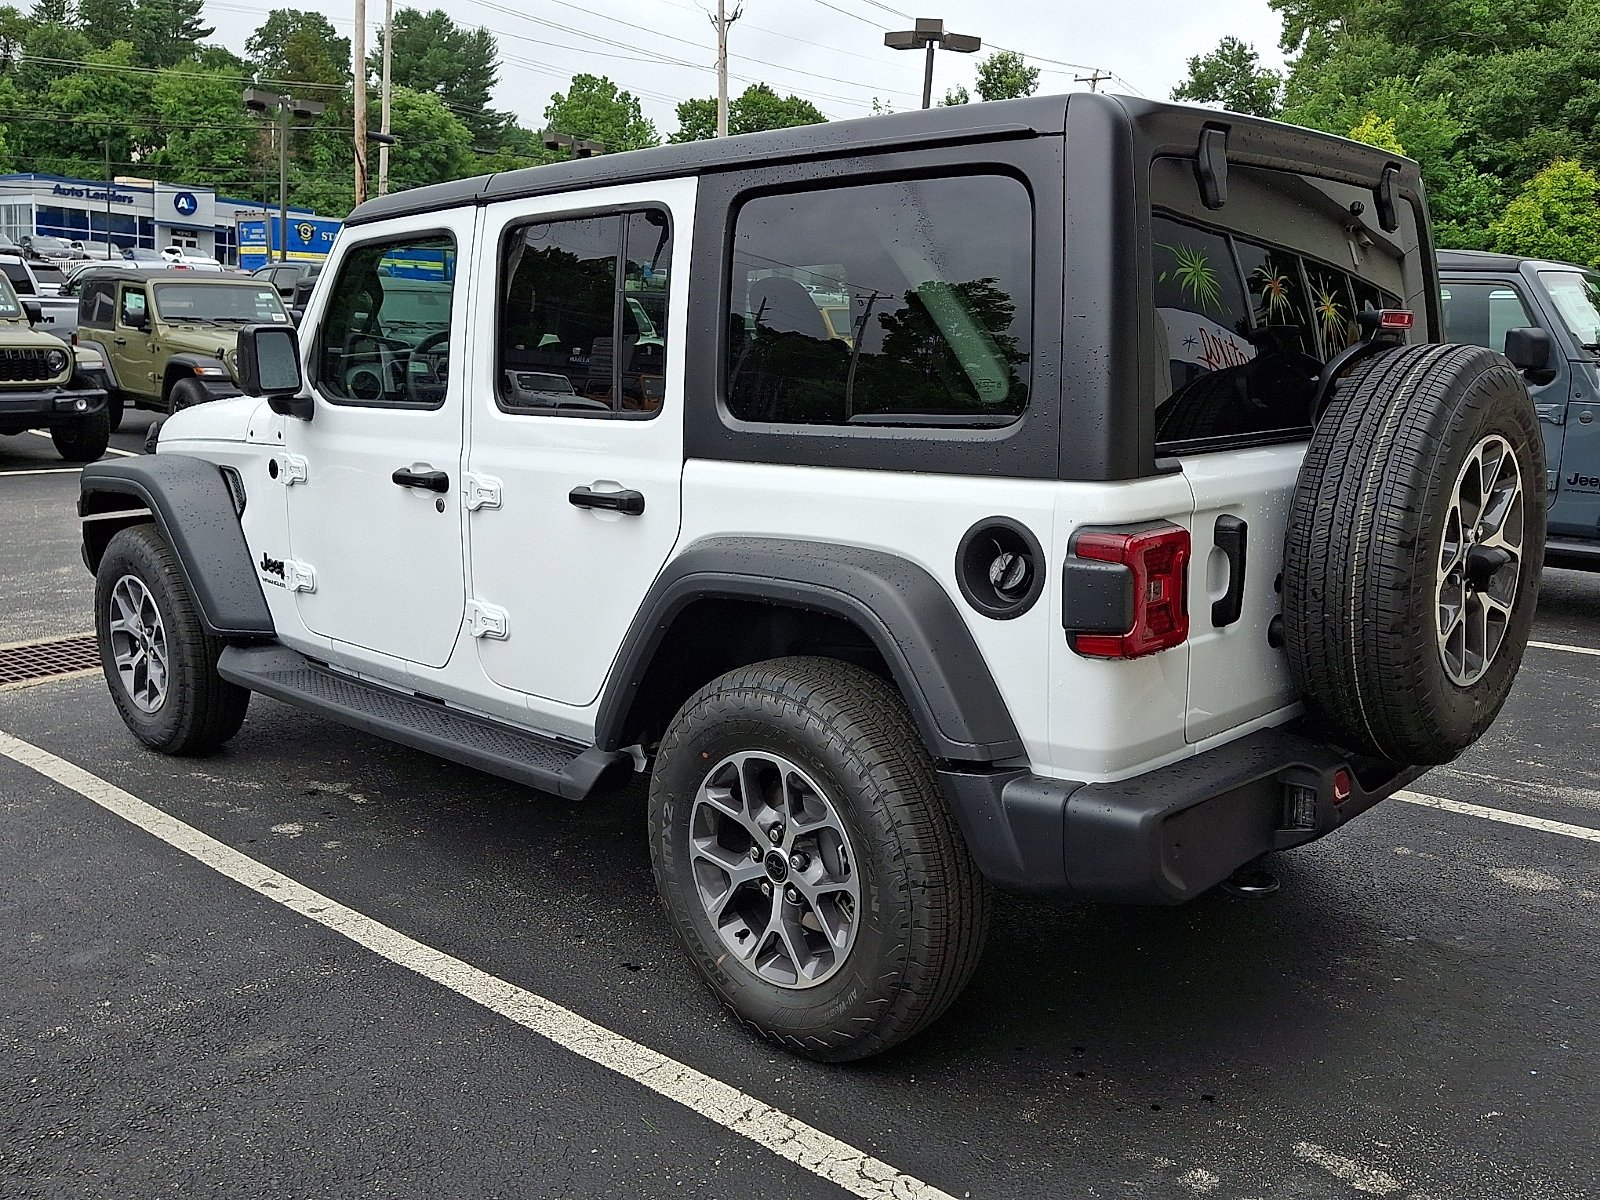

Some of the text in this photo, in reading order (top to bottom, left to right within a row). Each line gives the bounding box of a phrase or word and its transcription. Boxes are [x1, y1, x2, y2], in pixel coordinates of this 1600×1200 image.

[53, 183, 134, 204] Auto Lenders
[1566, 471, 1600, 489] Jee
[260, 551, 285, 580] Jeep
